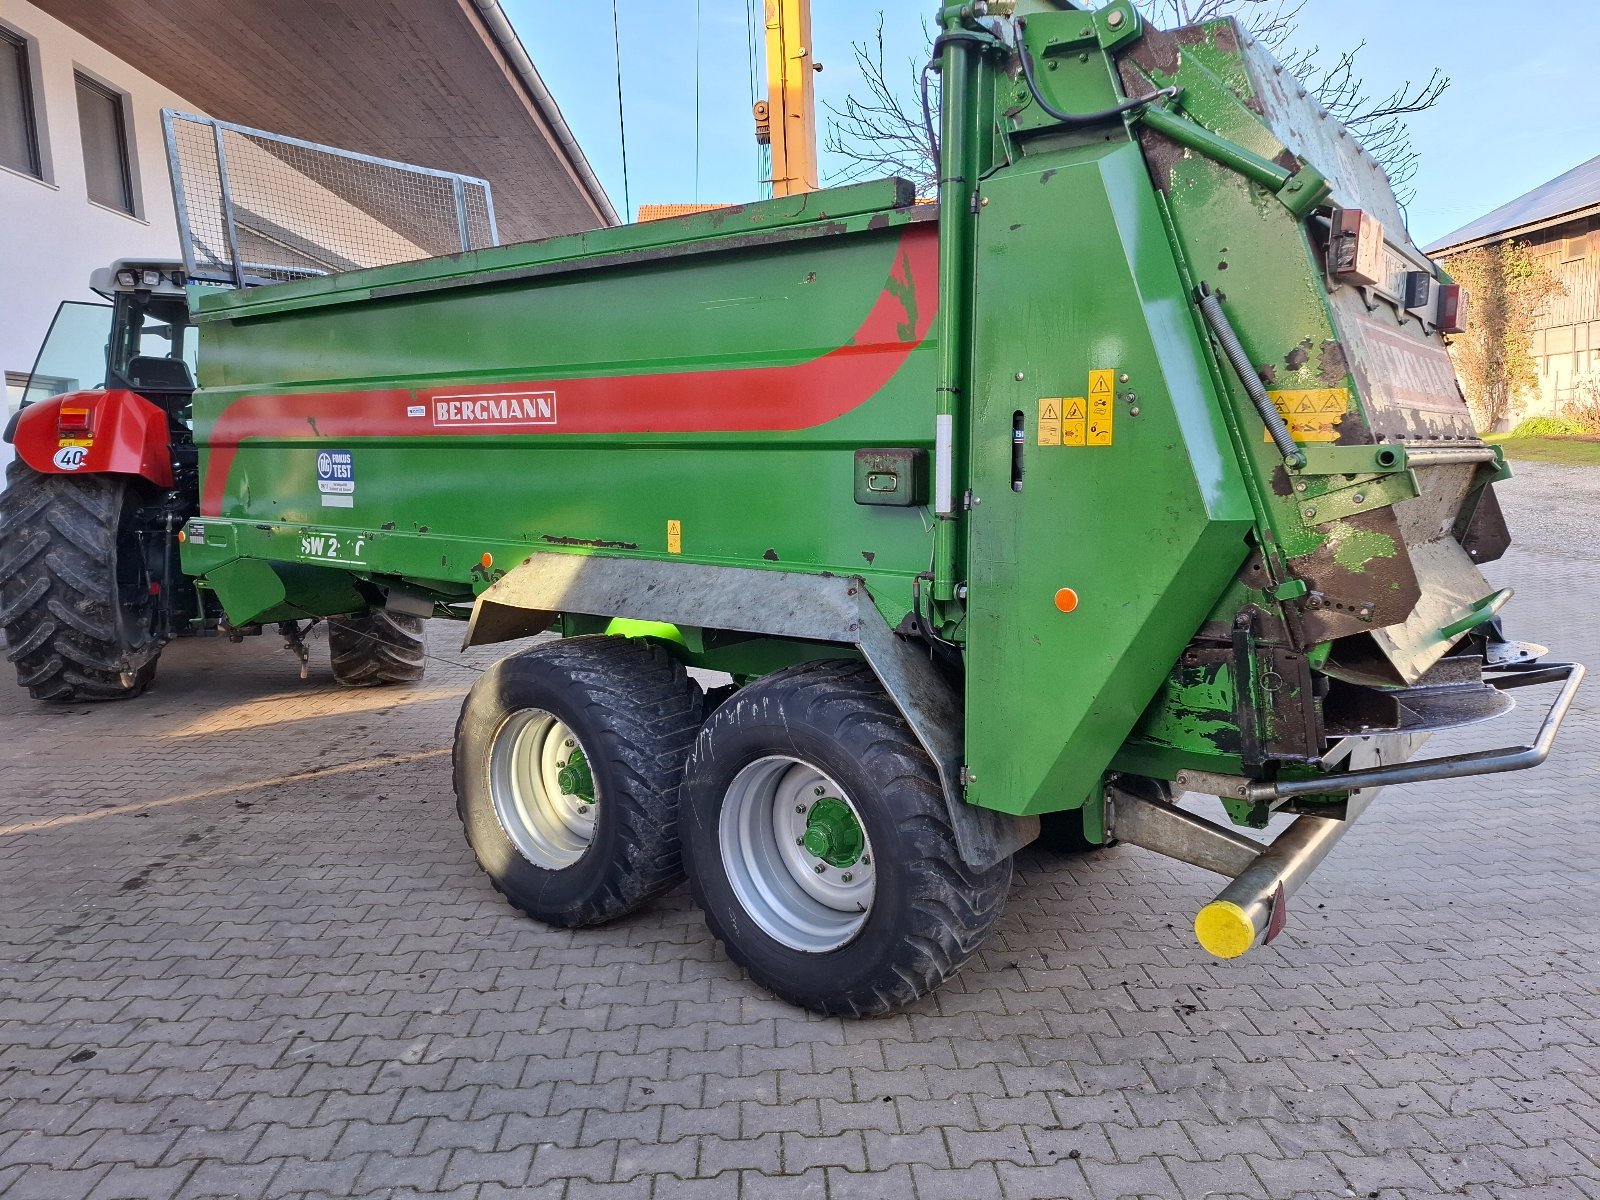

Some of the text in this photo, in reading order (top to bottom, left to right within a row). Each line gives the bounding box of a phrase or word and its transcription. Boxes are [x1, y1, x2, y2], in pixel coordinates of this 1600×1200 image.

[437, 398, 551, 420] BERGMANN
[332, 454, 351, 463] FOKUS
[332, 465, 351, 478] TEST
